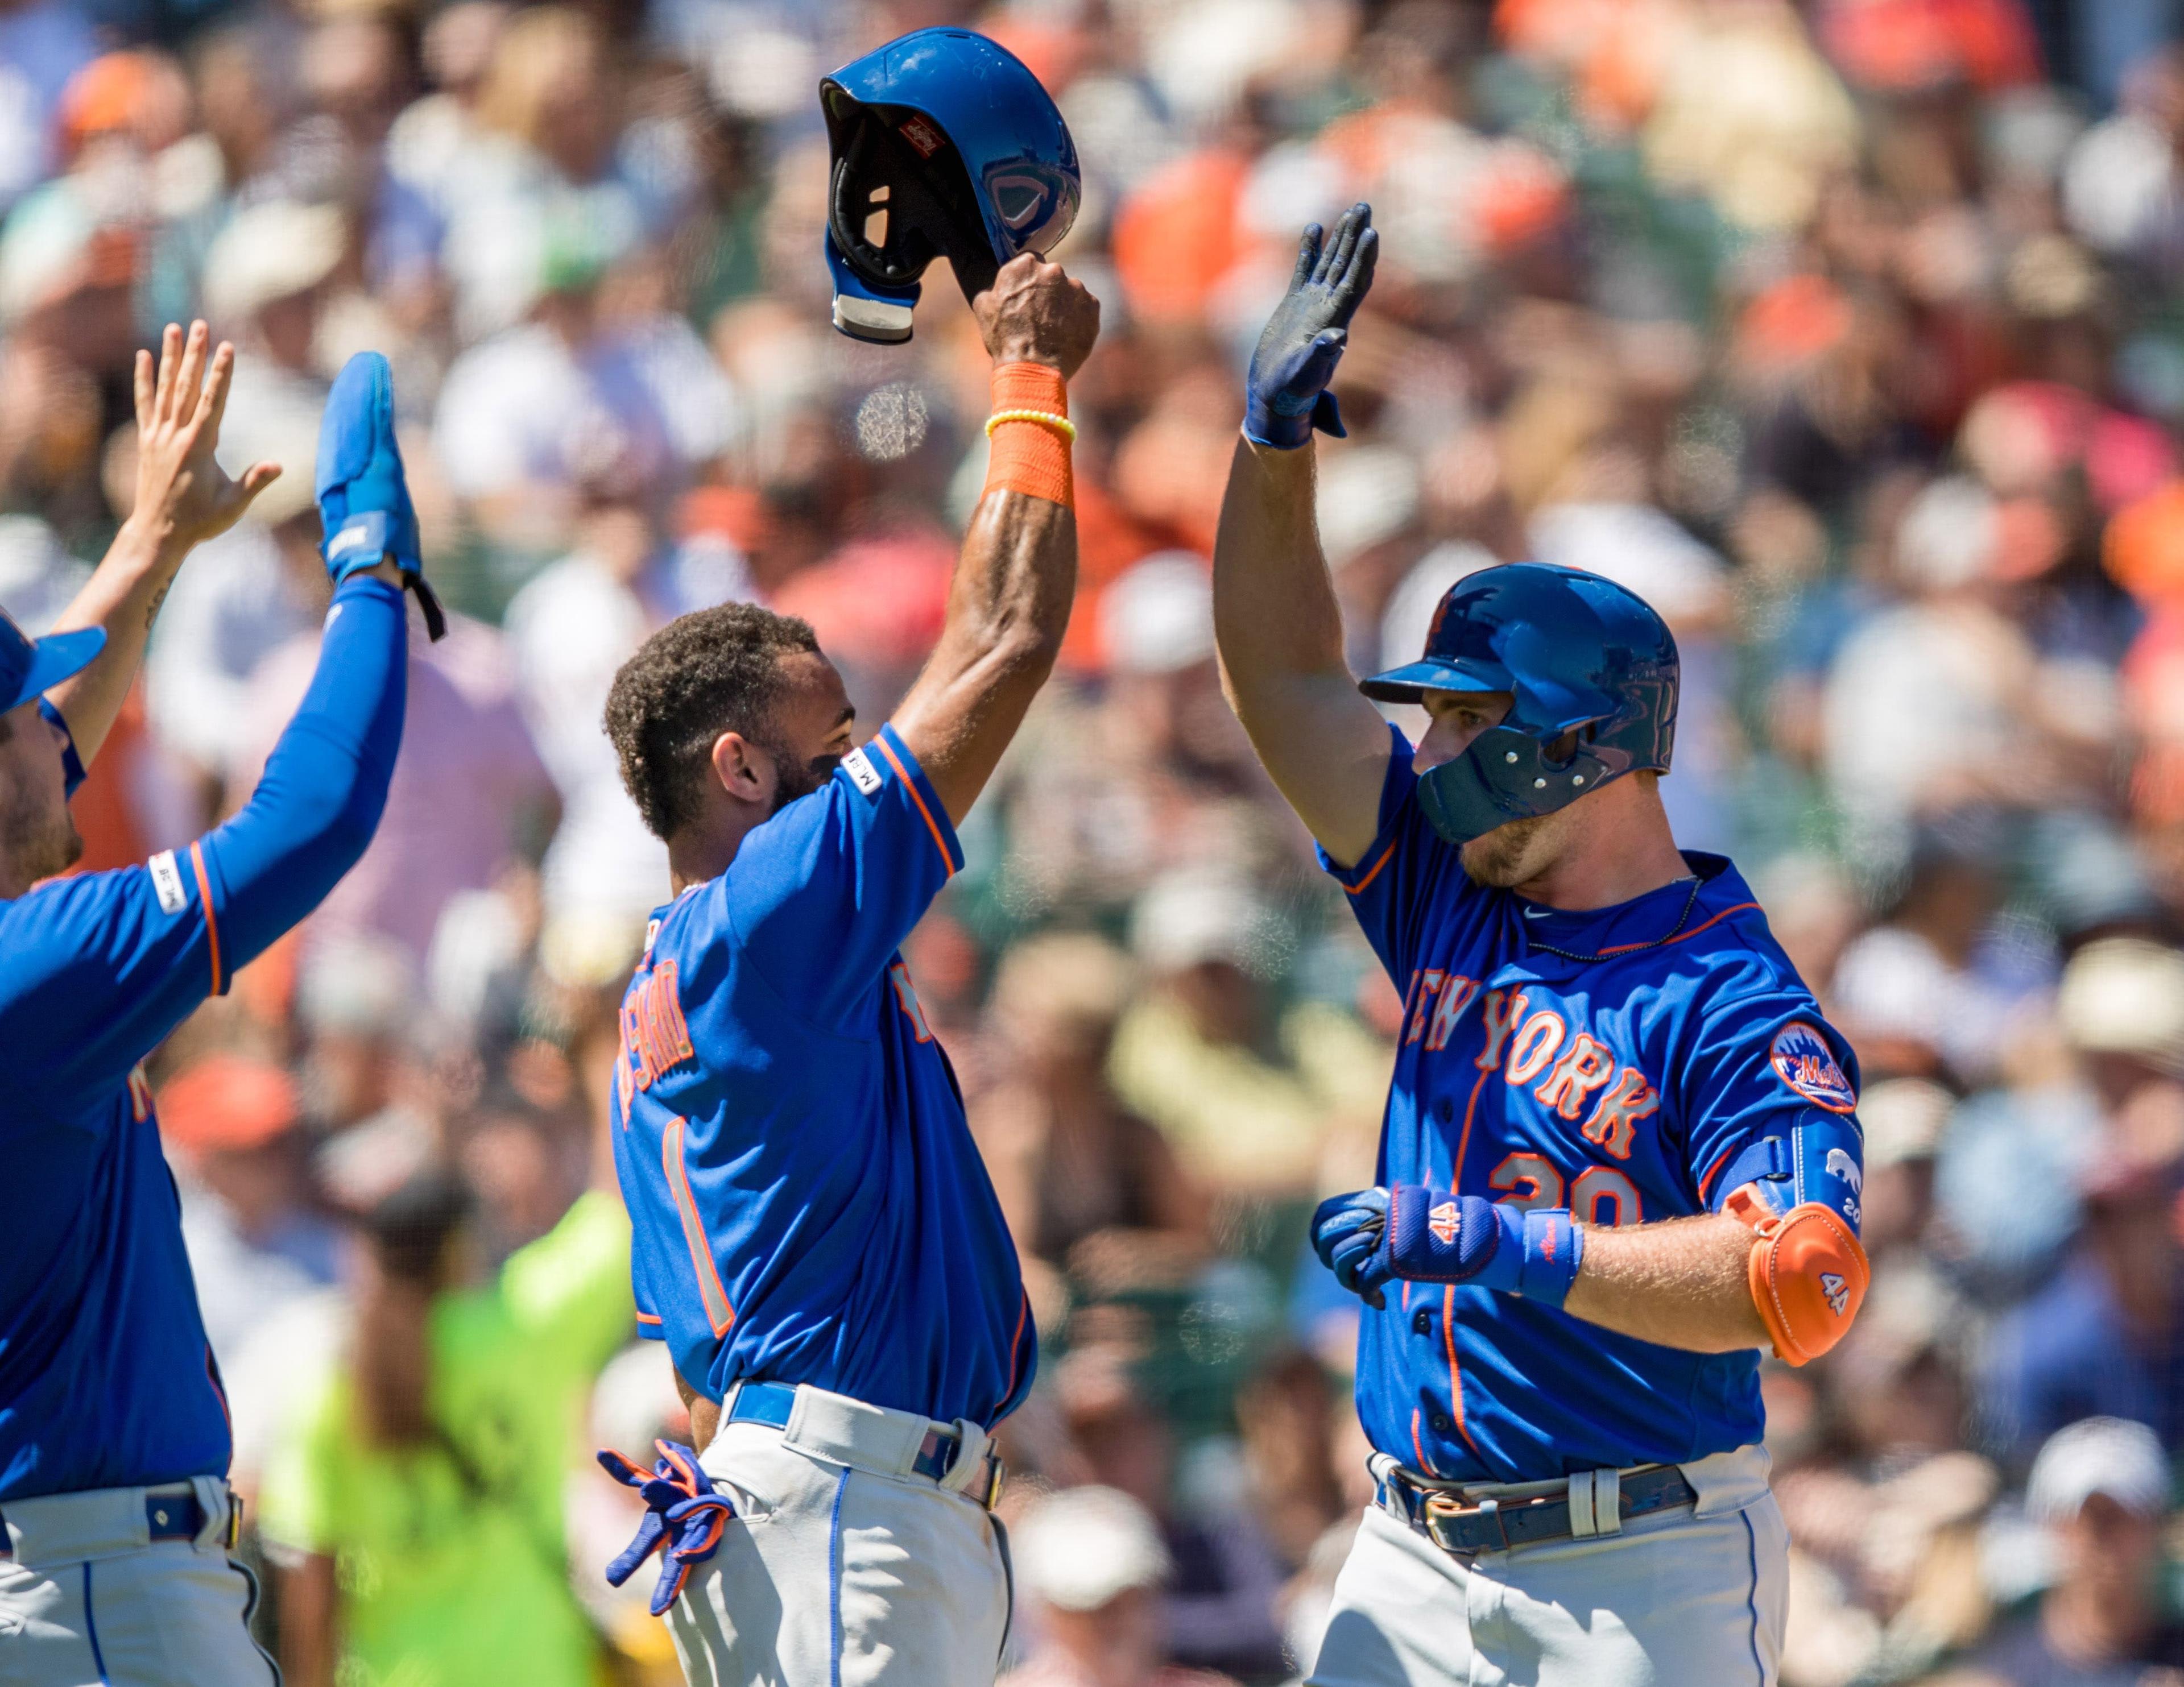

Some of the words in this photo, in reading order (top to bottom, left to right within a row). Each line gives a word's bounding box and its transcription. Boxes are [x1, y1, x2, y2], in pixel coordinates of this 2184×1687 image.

[1474, 983, 1661, 1160] YORK
[1795, 1054, 1845, 1090] Mets
[662, 1116, 736, 1340] 1
[1843, 1197, 1860, 1224] 20
